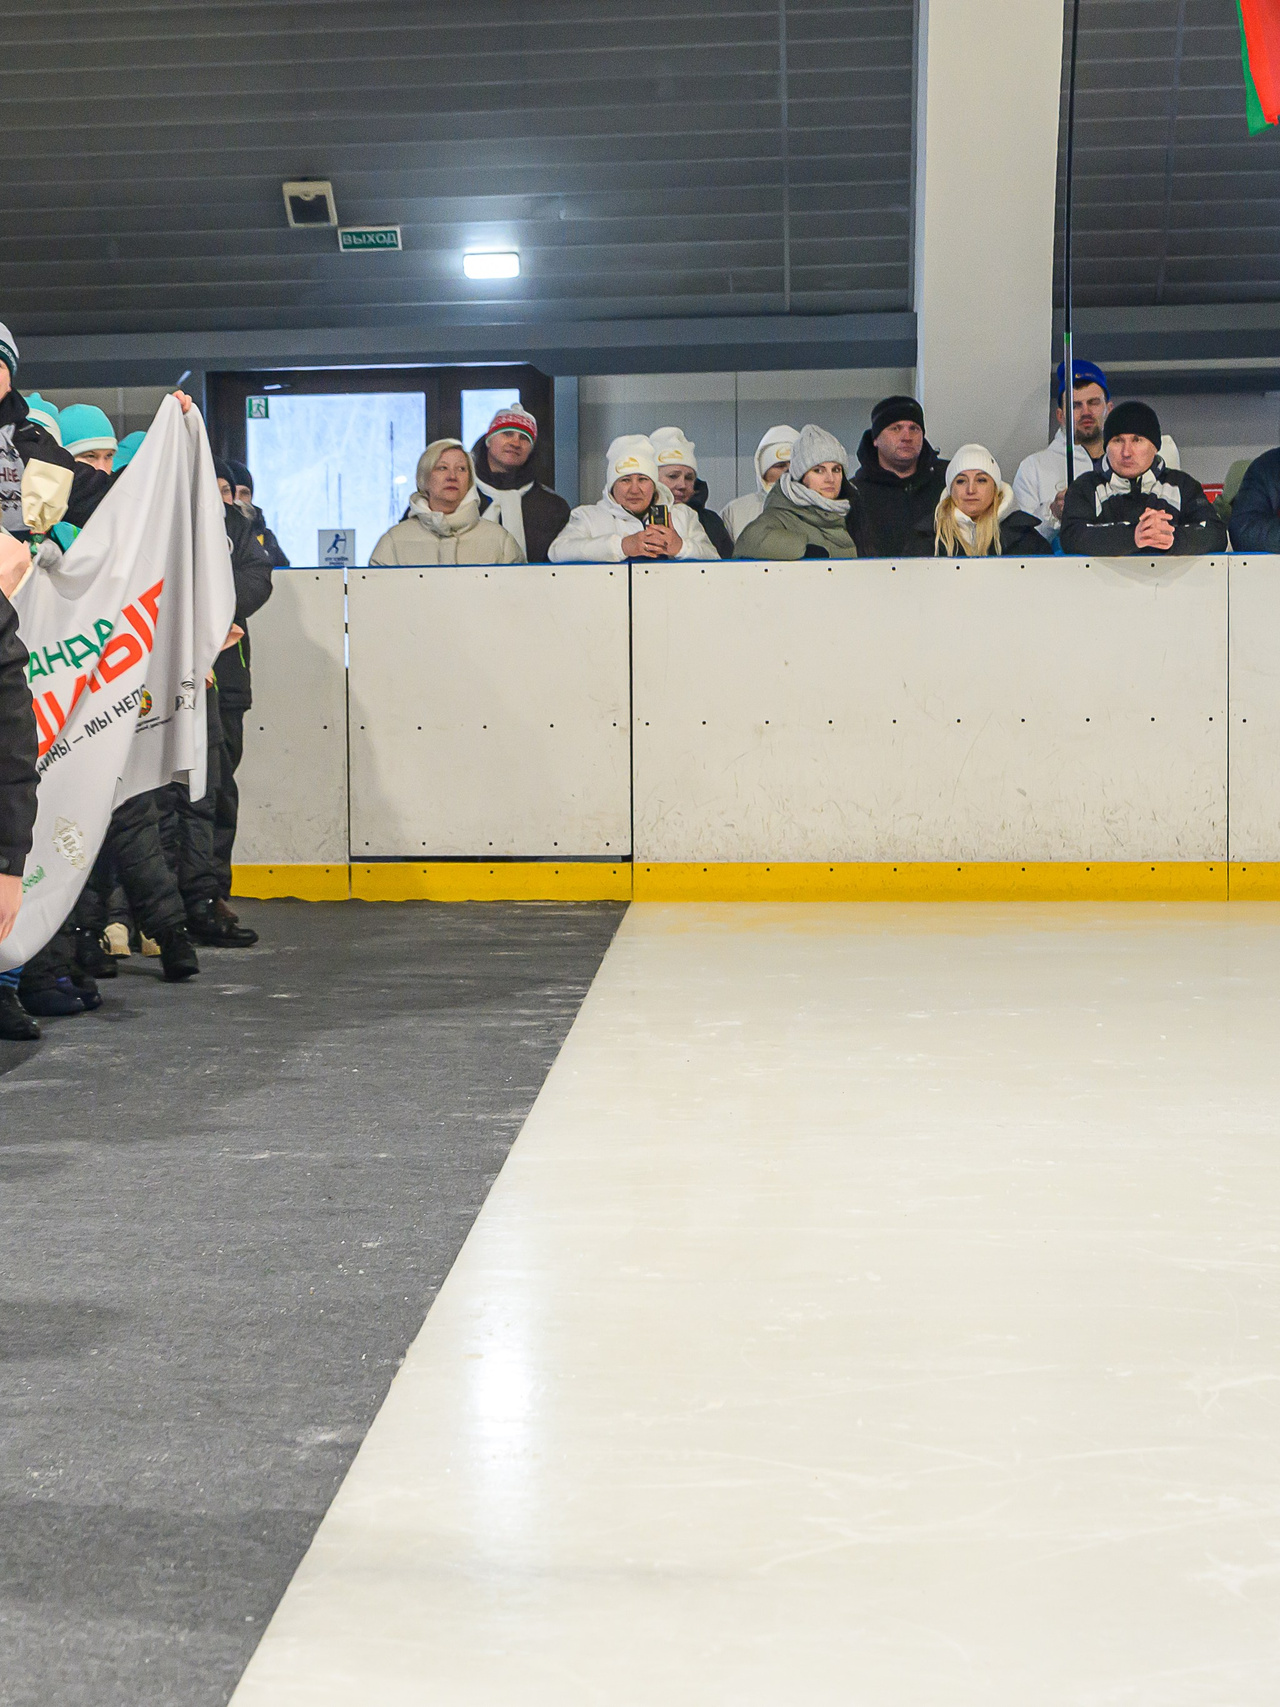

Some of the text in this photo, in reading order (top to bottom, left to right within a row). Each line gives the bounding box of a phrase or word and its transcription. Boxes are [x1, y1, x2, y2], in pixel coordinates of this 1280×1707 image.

[342, 233, 398, 246] ВЫХОД
[28, 618, 114, 684] АНДА
[83, 711, 113, 738] МЫ
